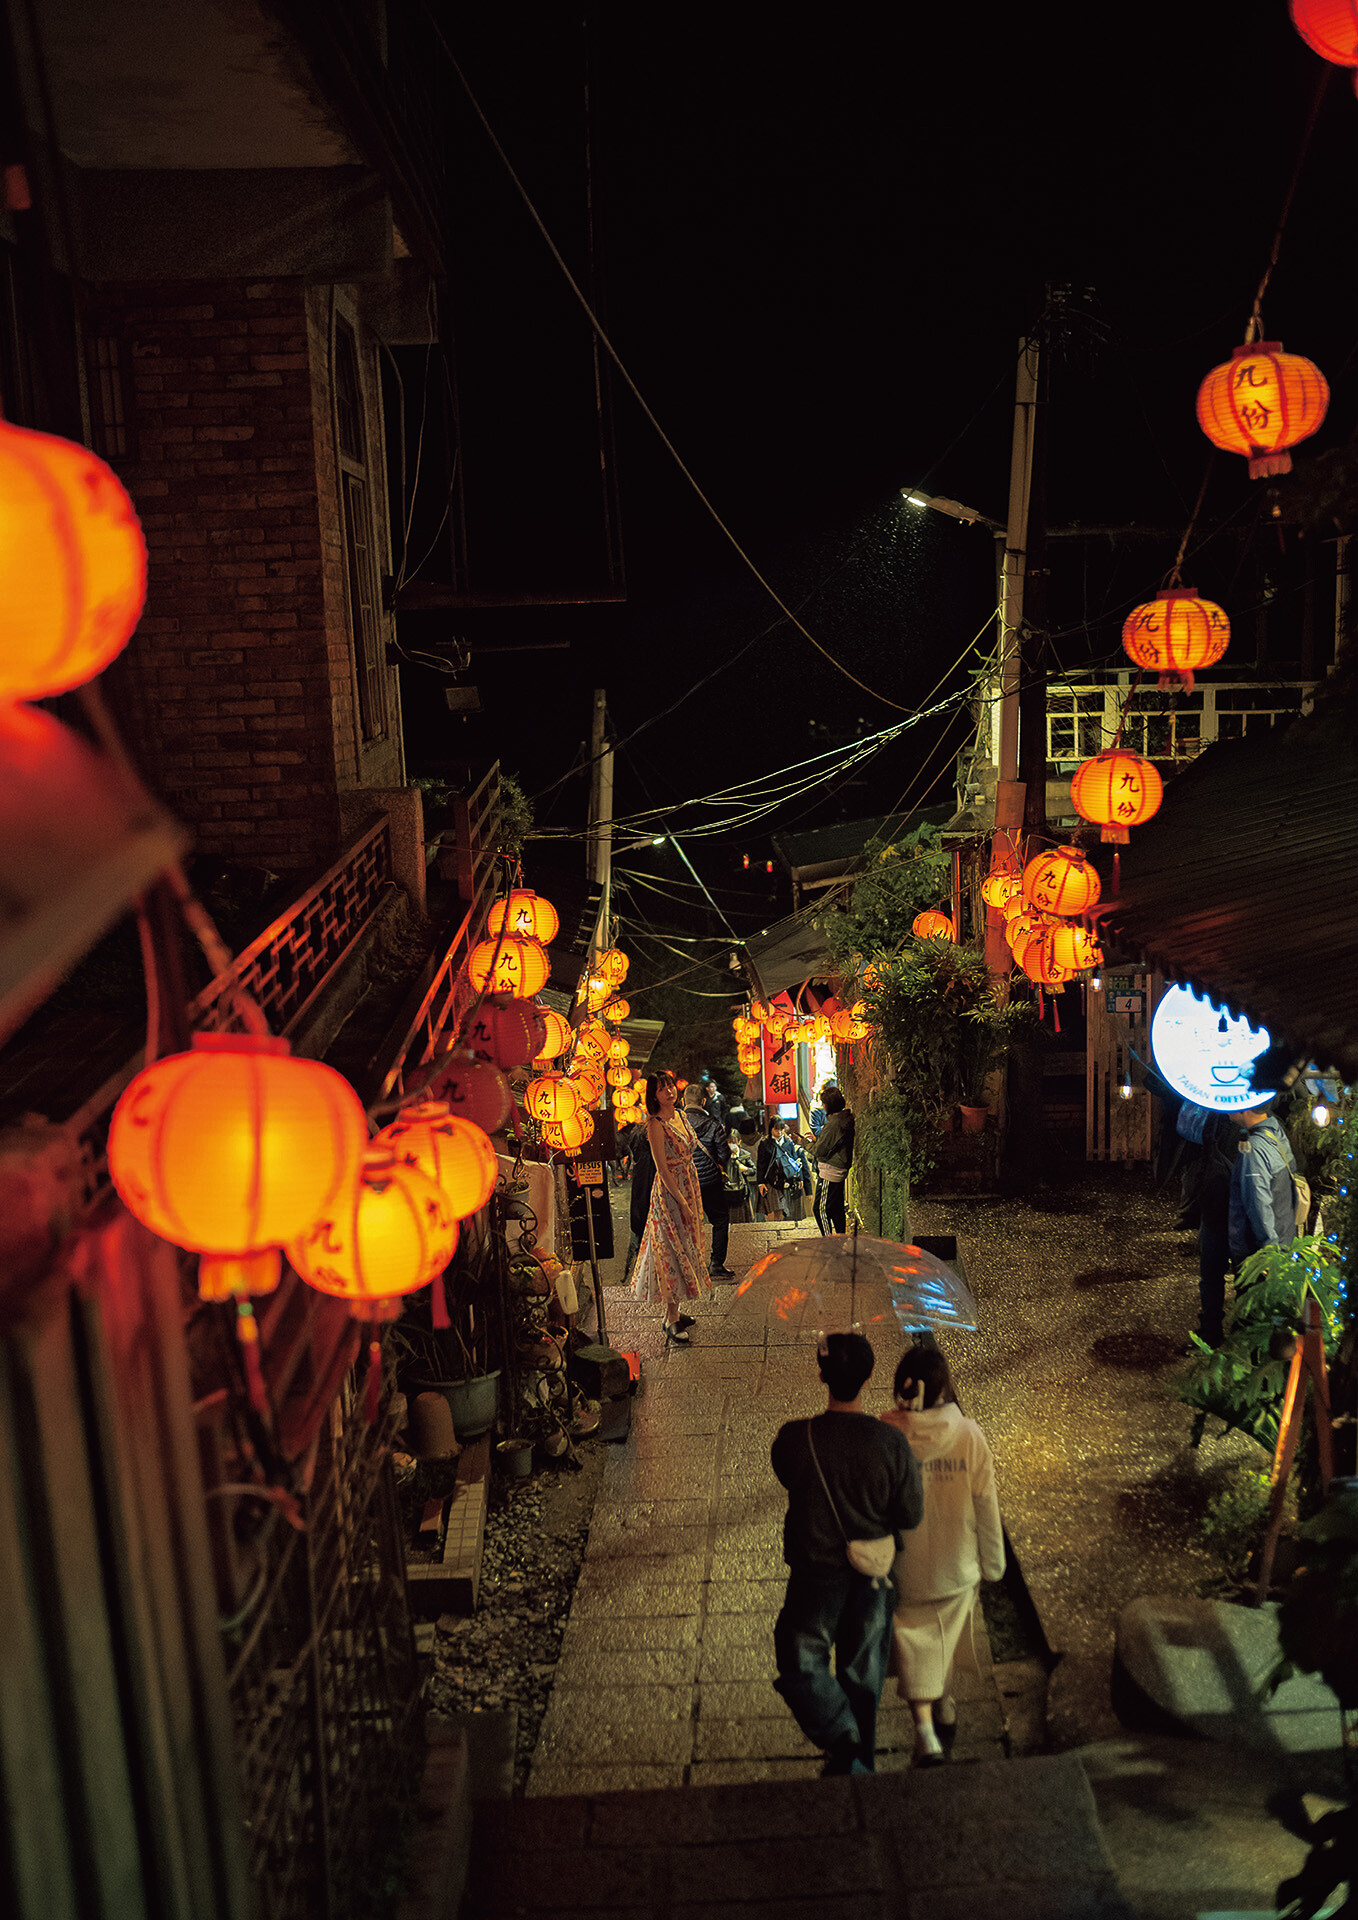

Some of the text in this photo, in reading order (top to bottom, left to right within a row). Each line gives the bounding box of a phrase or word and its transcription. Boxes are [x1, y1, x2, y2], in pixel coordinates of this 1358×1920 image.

[1234, 365, 1272, 430] 九份
[1136, 612, 1160, 664] 九份
[1117, 771, 1140, 818] 九份
[1037, 870, 1057, 907] 九份
[1125, 998, 1133, 1010] 4
[537, 1090, 552, 1119] 九份
[579, 1161, 601, 1170] JESUS
